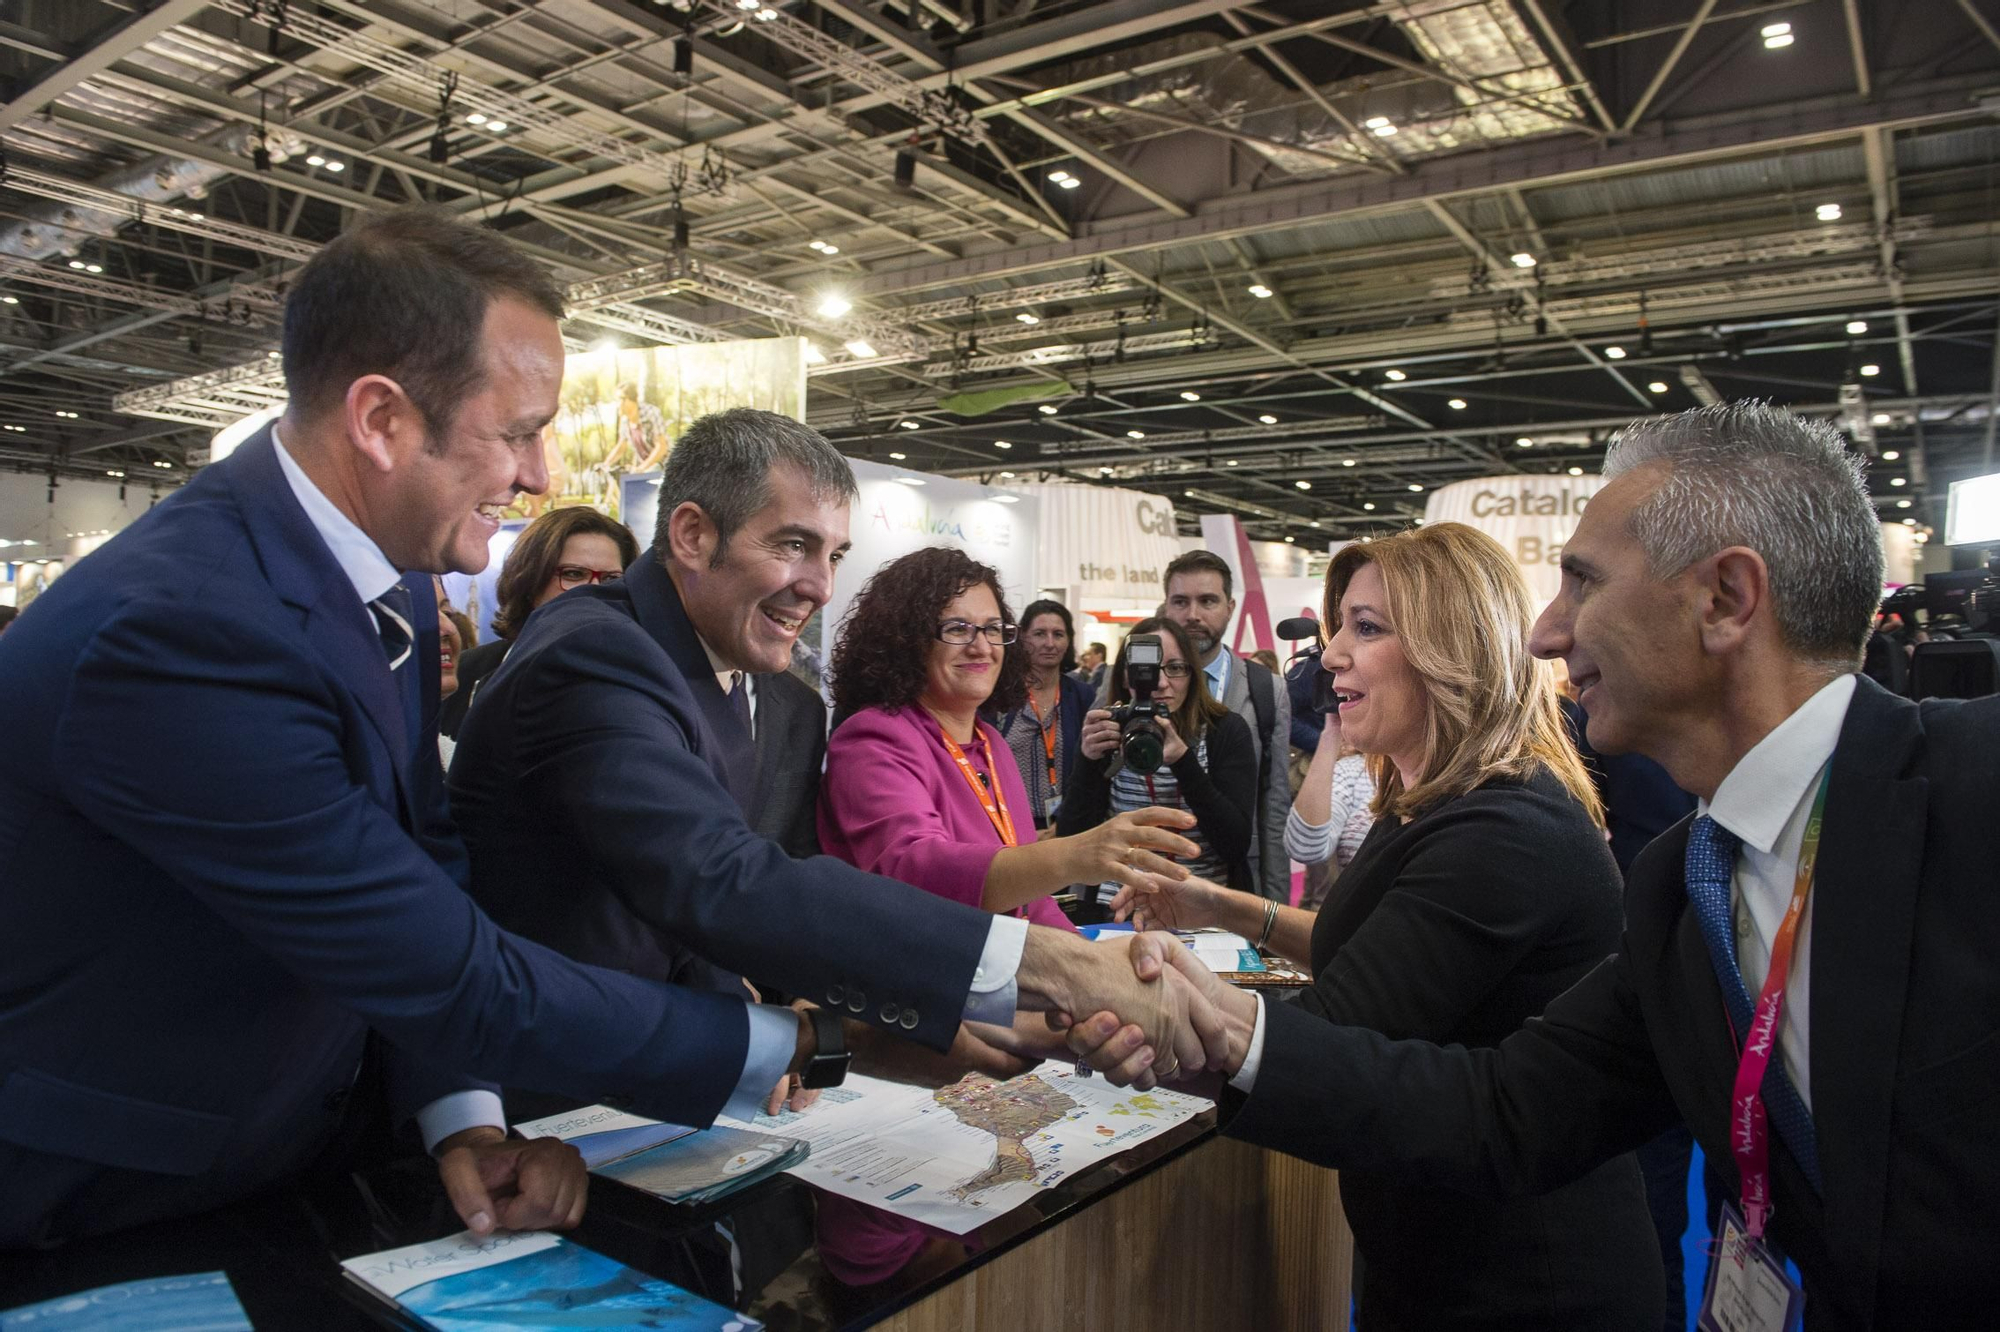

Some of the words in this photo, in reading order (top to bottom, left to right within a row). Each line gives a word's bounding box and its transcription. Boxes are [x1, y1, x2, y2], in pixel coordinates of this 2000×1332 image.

[871, 501, 967, 542] Adalucía
[1079, 563, 1116, 581] the
[1123, 564, 1158, 583] land
[1750, 989, 1782, 1057] Andalucía
[367, 1251, 455, 1274] Water
